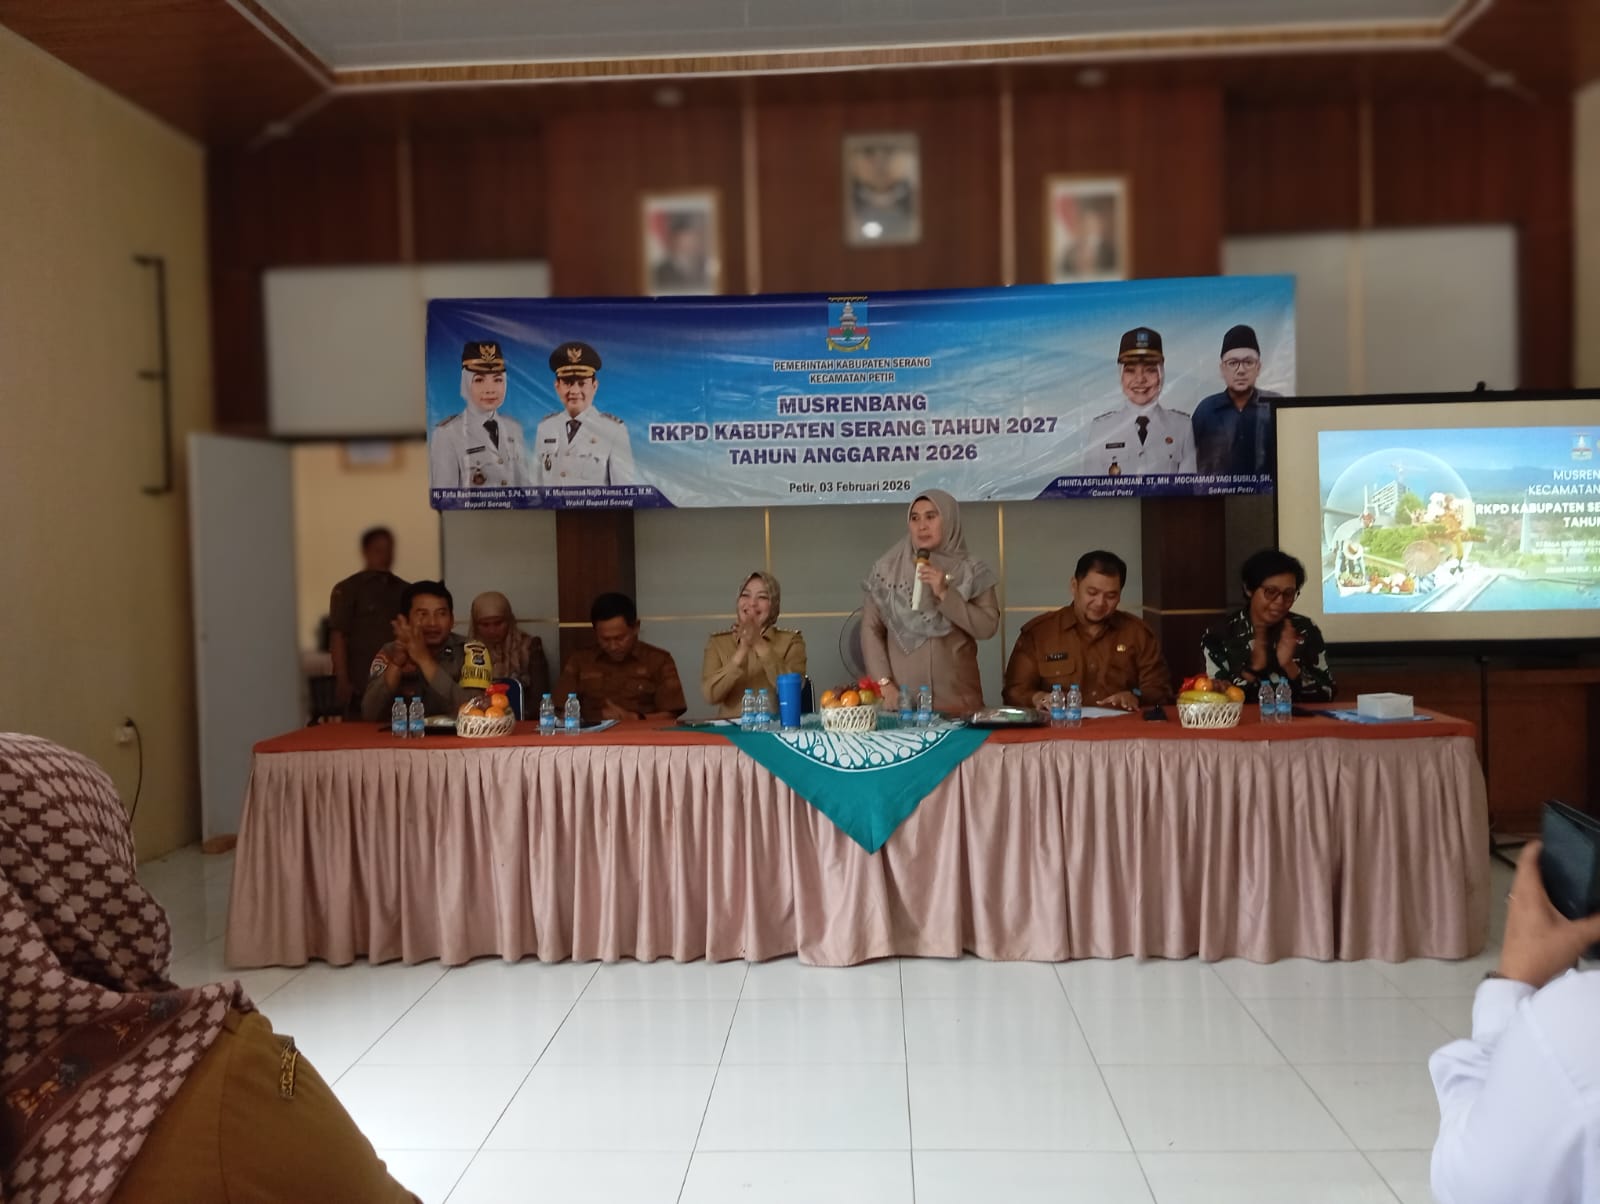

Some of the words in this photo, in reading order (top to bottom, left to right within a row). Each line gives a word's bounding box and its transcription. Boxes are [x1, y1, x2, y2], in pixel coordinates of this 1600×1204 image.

[774, 359, 833, 371] PEMERINTAH
[836, 358, 890, 370] KABUPATEN
[892, 357, 931, 368] SERANG
[810, 373, 866, 384] KECAMATAN
[868, 372, 895, 382] PETIR
[778, 394, 927, 414] MUSRENBANG
[649, 424, 709, 442] RKPD
[713, 421, 836, 440] KABUPATEN
[840, 419, 927, 438] SERANG
[931, 417, 1001, 435] TAHUN
[1006, 416, 1058, 434] 2027
[728, 448, 797, 465] TAHUN
[802, 445, 920, 464] ANGGARAN
[925, 444, 978, 461] 2026
[1057, 478, 1082, 487] SHINTA
[1082, 478, 1113, 487] ASFILIAN
[1157, 476, 1169, 485] MH
[1174, 474, 1215, 484] MOCHAMAD
[553, 488, 586, 496] Muhammad
[789, 482, 817, 493] Petir,
[819, 482, 834, 492] 03
[836, 480, 880, 492] Februari
[882, 480, 911, 491] 2026
[1092, 489, 1115, 497] Camat
[1116, 488, 1133, 497] Petir
[1208, 487, 1235, 495] Sekmat
[1237, 486, 1254, 494] Petir
[1528, 484, 1600, 496] KECAMATAN
[465, 501, 486, 510] Bupati
[487, 500, 511, 509] Serang
[565, 499, 585, 507] Wakil
[586, 498, 608, 508] Bupati
[609, 498, 634, 507] Serang
[1475, 503, 1510, 515] RKPD
[1511, 502, 1585, 514] KABUPATEN
